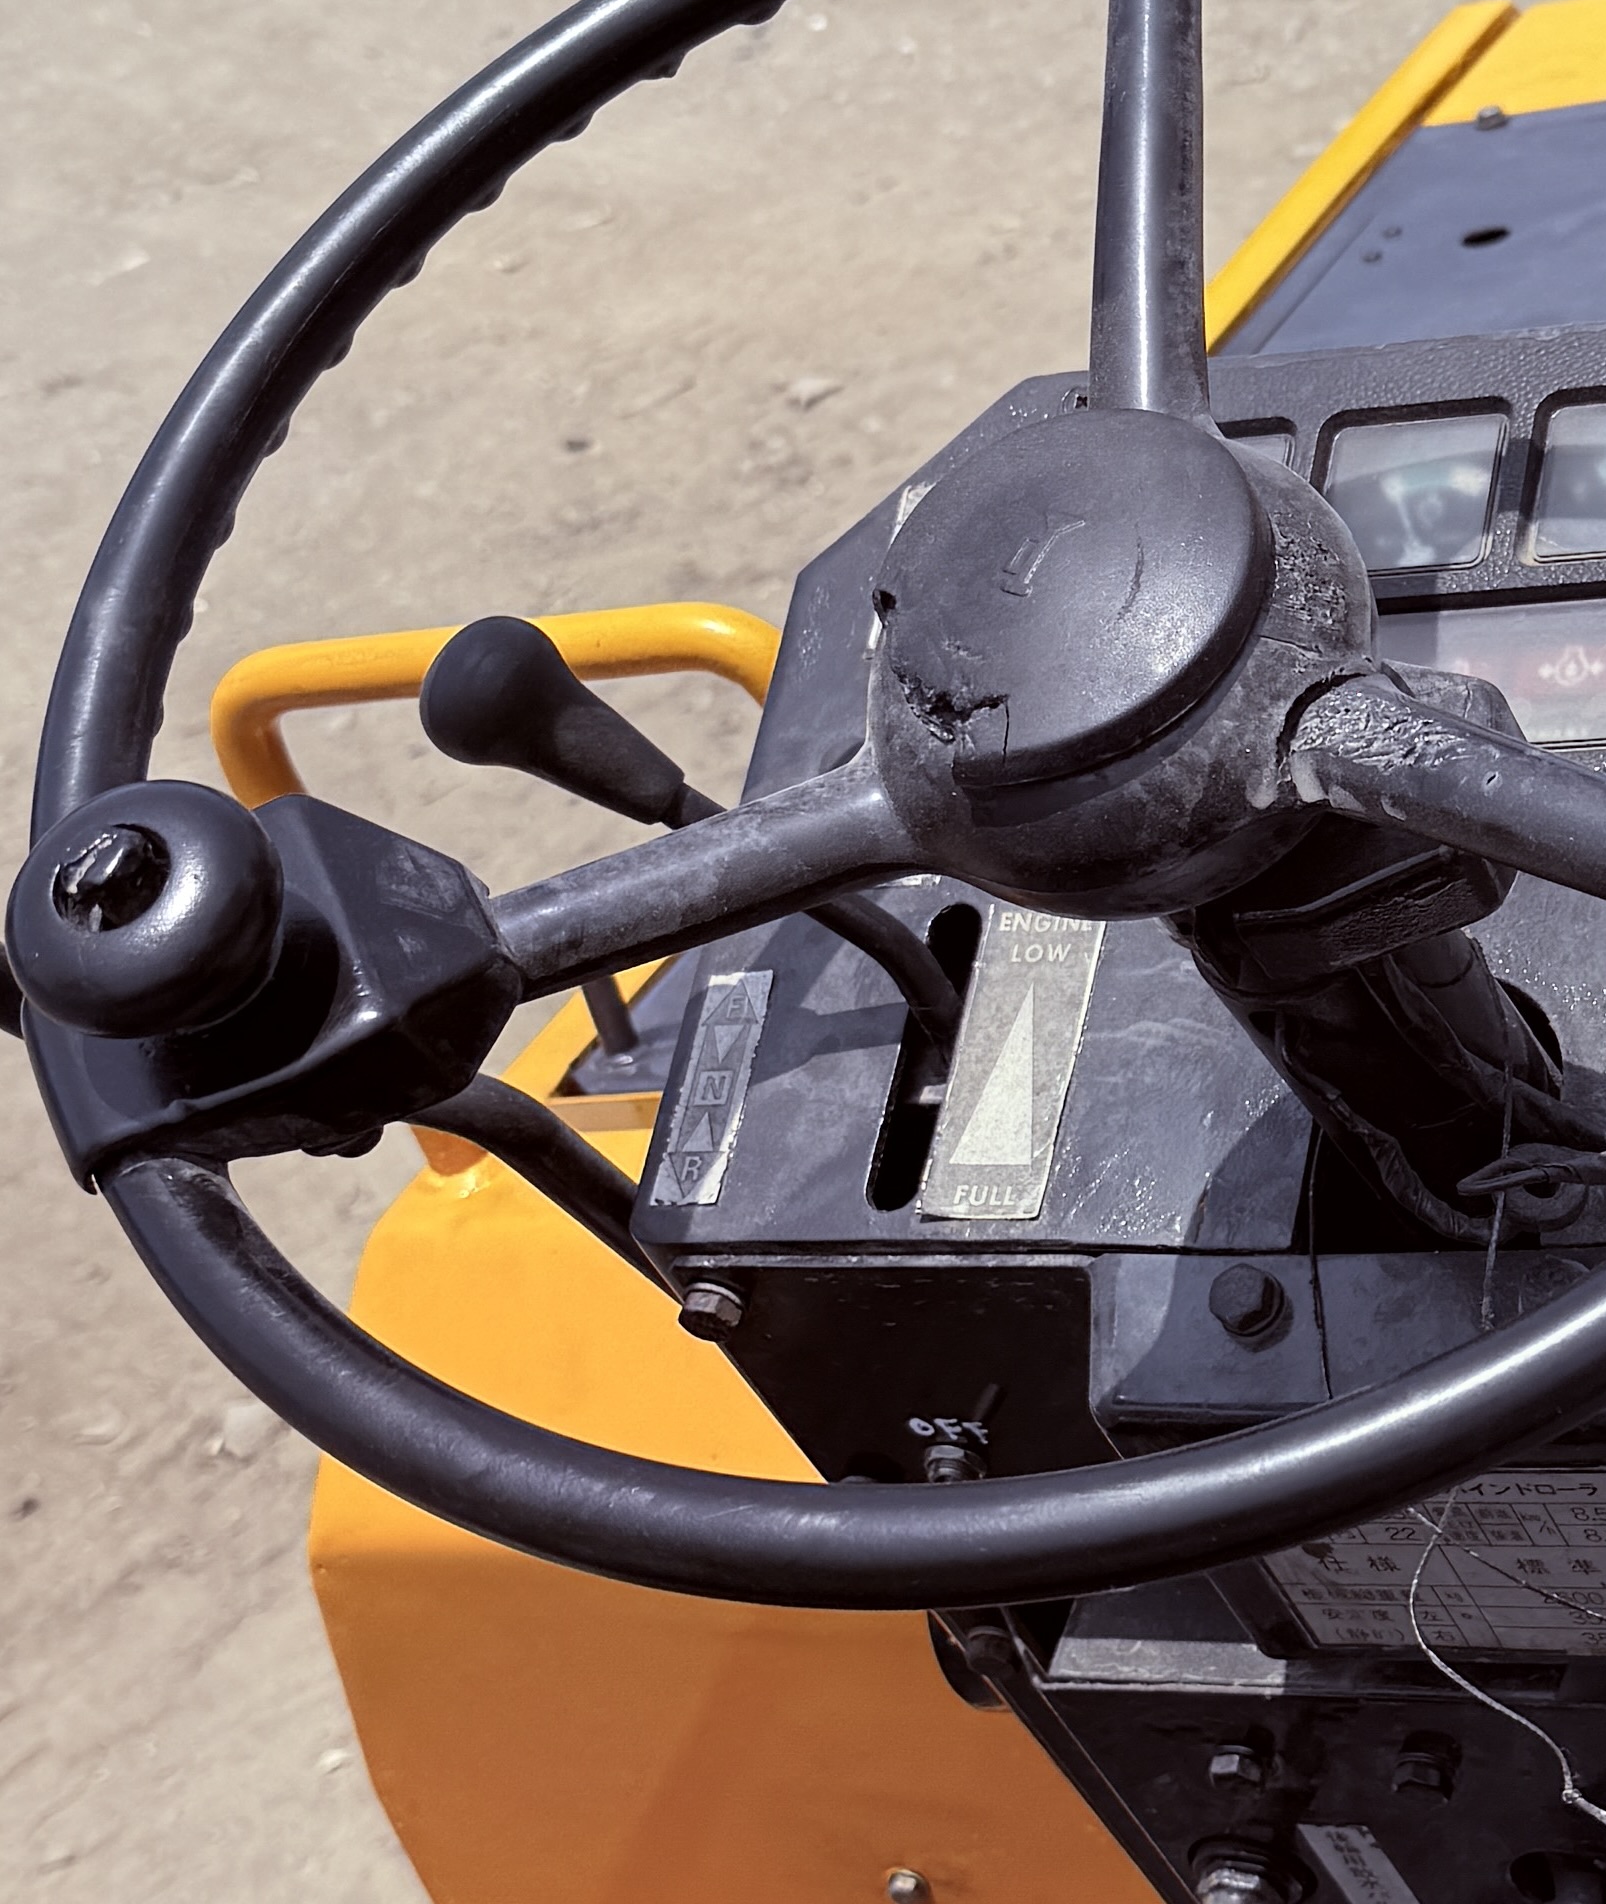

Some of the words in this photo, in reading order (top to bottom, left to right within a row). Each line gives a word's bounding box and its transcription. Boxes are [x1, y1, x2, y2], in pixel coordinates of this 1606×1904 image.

[999, 912, 1092, 932] ENGINE
[1011, 943, 1071, 963] LOW
[703, 1075, 727, 1101] N
[681, 1156, 702, 1182] R
[953, 1185, 1016, 1206] FULL
[908, 1417, 988, 1444] OFF
[1458, 1482, 1598, 1497] インドローラ
[1384, 1527, 1419, 1541] 22
